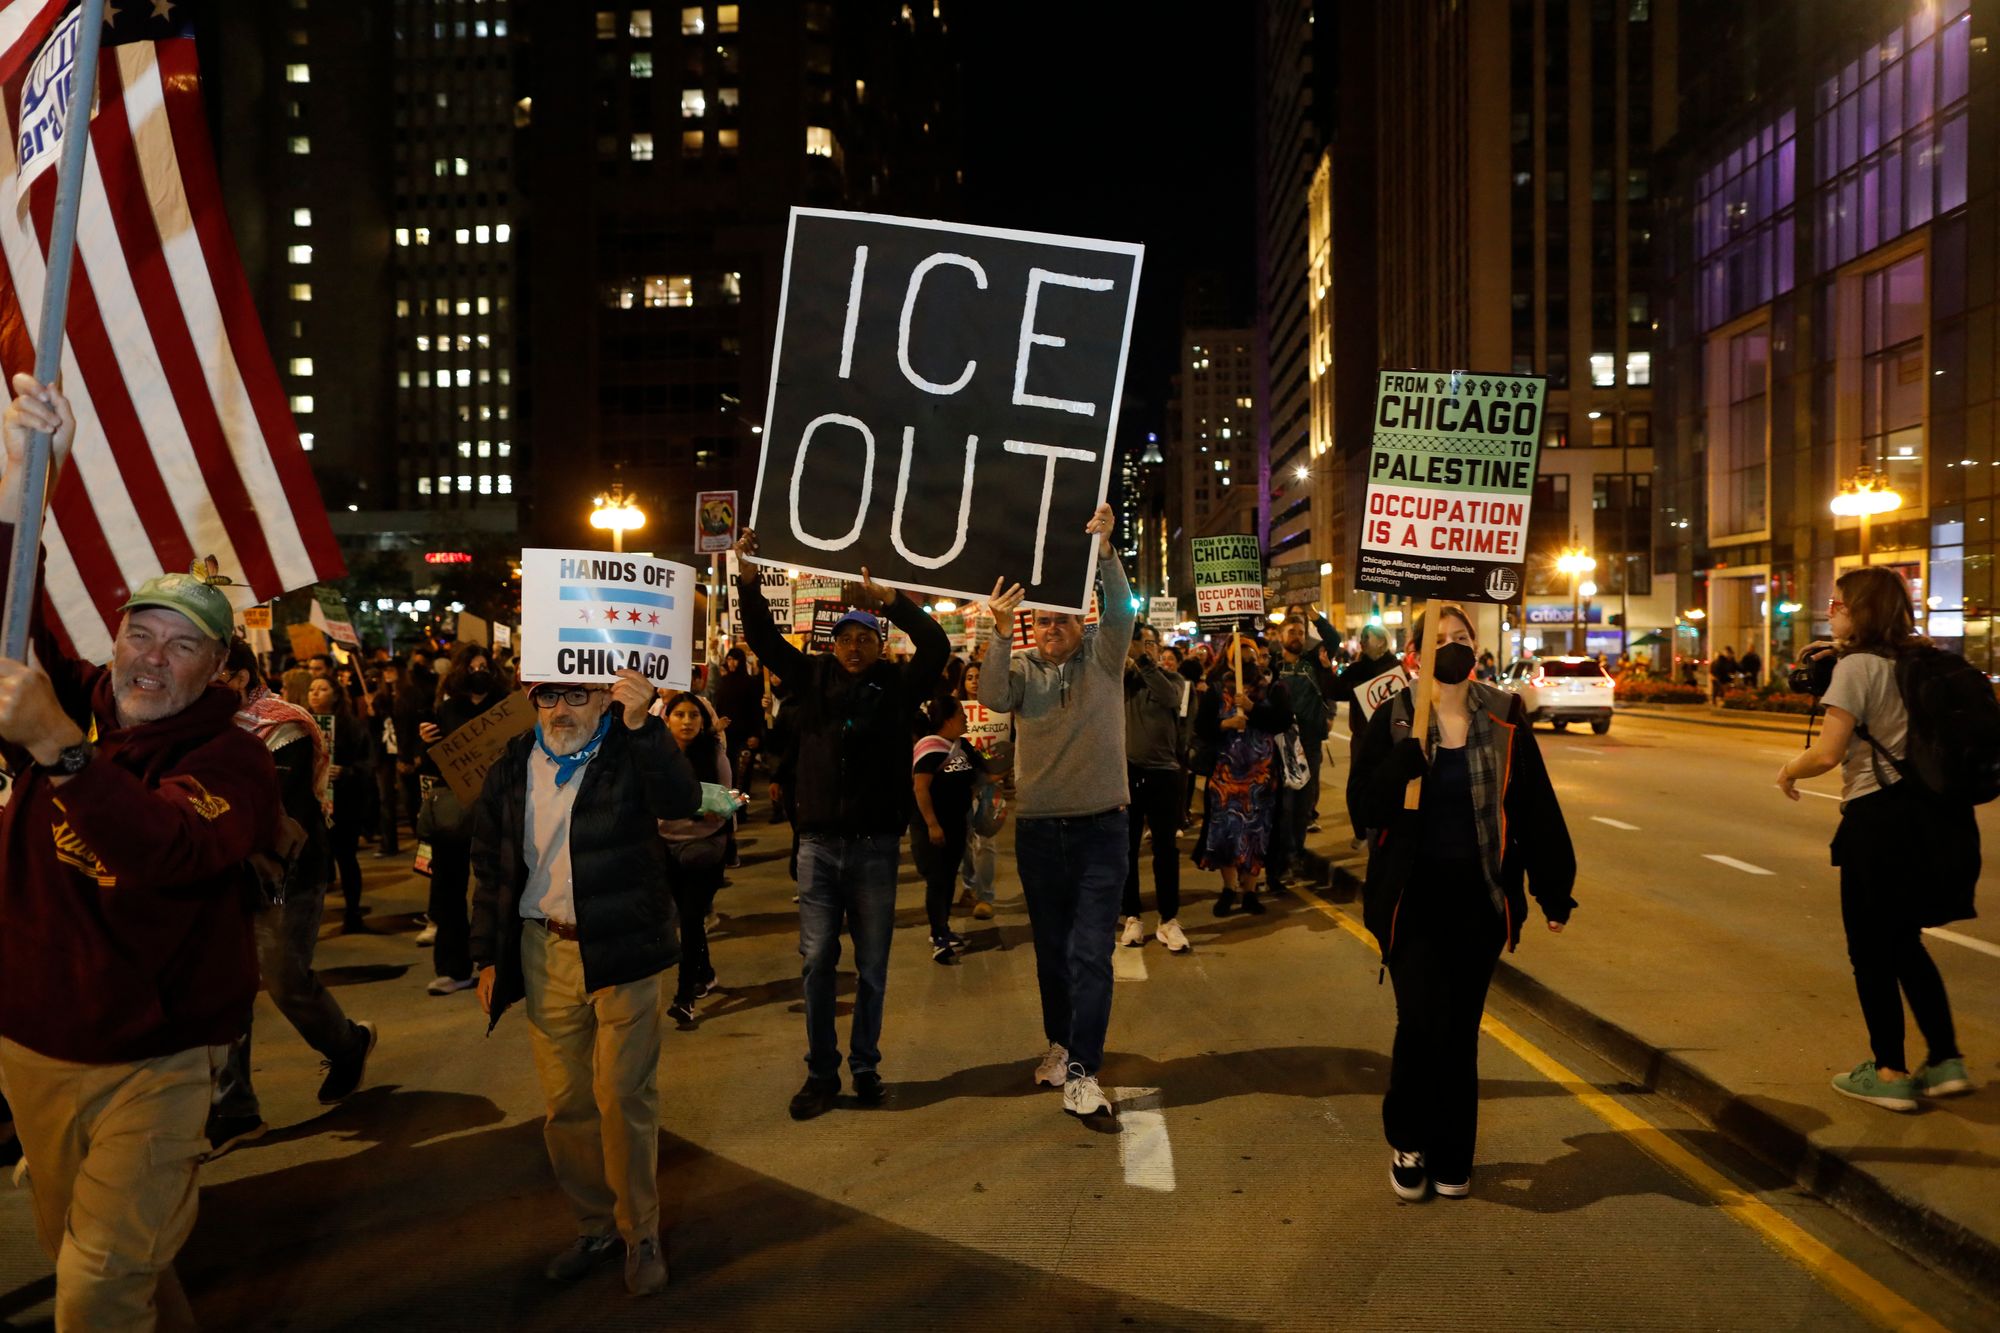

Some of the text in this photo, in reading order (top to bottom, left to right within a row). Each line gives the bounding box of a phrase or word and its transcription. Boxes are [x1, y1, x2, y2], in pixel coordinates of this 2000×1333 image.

[838, 245, 1114, 416] ICE
[1384, 375, 1428, 393] FROM
[1379, 395, 1537, 436] CHICAGO
[1510, 441, 1532, 458] TO
[1372, 452, 1530, 488] PALESTINE
[790, 413, 1096, 586] OUT
[1370, 493, 1523, 526] OCCUPATION
[1193, 539, 1215, 547] FROM
[1368, 520, 1518, 555] IS A CRIME!
[1194, 545, 1258, 562] CHICAGO
[560, 558, 675, 588] HANDS OFF
[1362, 556, 1474, 573] Chicago Alliance Against Racist
[730, 574, 789, 586] DAND:
[1196, 569, 1260, 584] PALESTINE
[1376, 567, 1404, 578] Political
[1404, 571, 1447, 583] Repression
[1198, 588, 1261, 601] OCCUPATION
[1200, 600, 1262, 613] IS A CRIME!
[816, 610, 832, 621] ARE
[816, 635, 830, 643] just
[557, 648, 669, 681] CHICAGO
[1370, 681, 1399, 703] ICE
[441, 700, 512, 758] RELEASE
[971, 723, 1009, 733] AMERICA
[449, 744, 482, 772] THE
